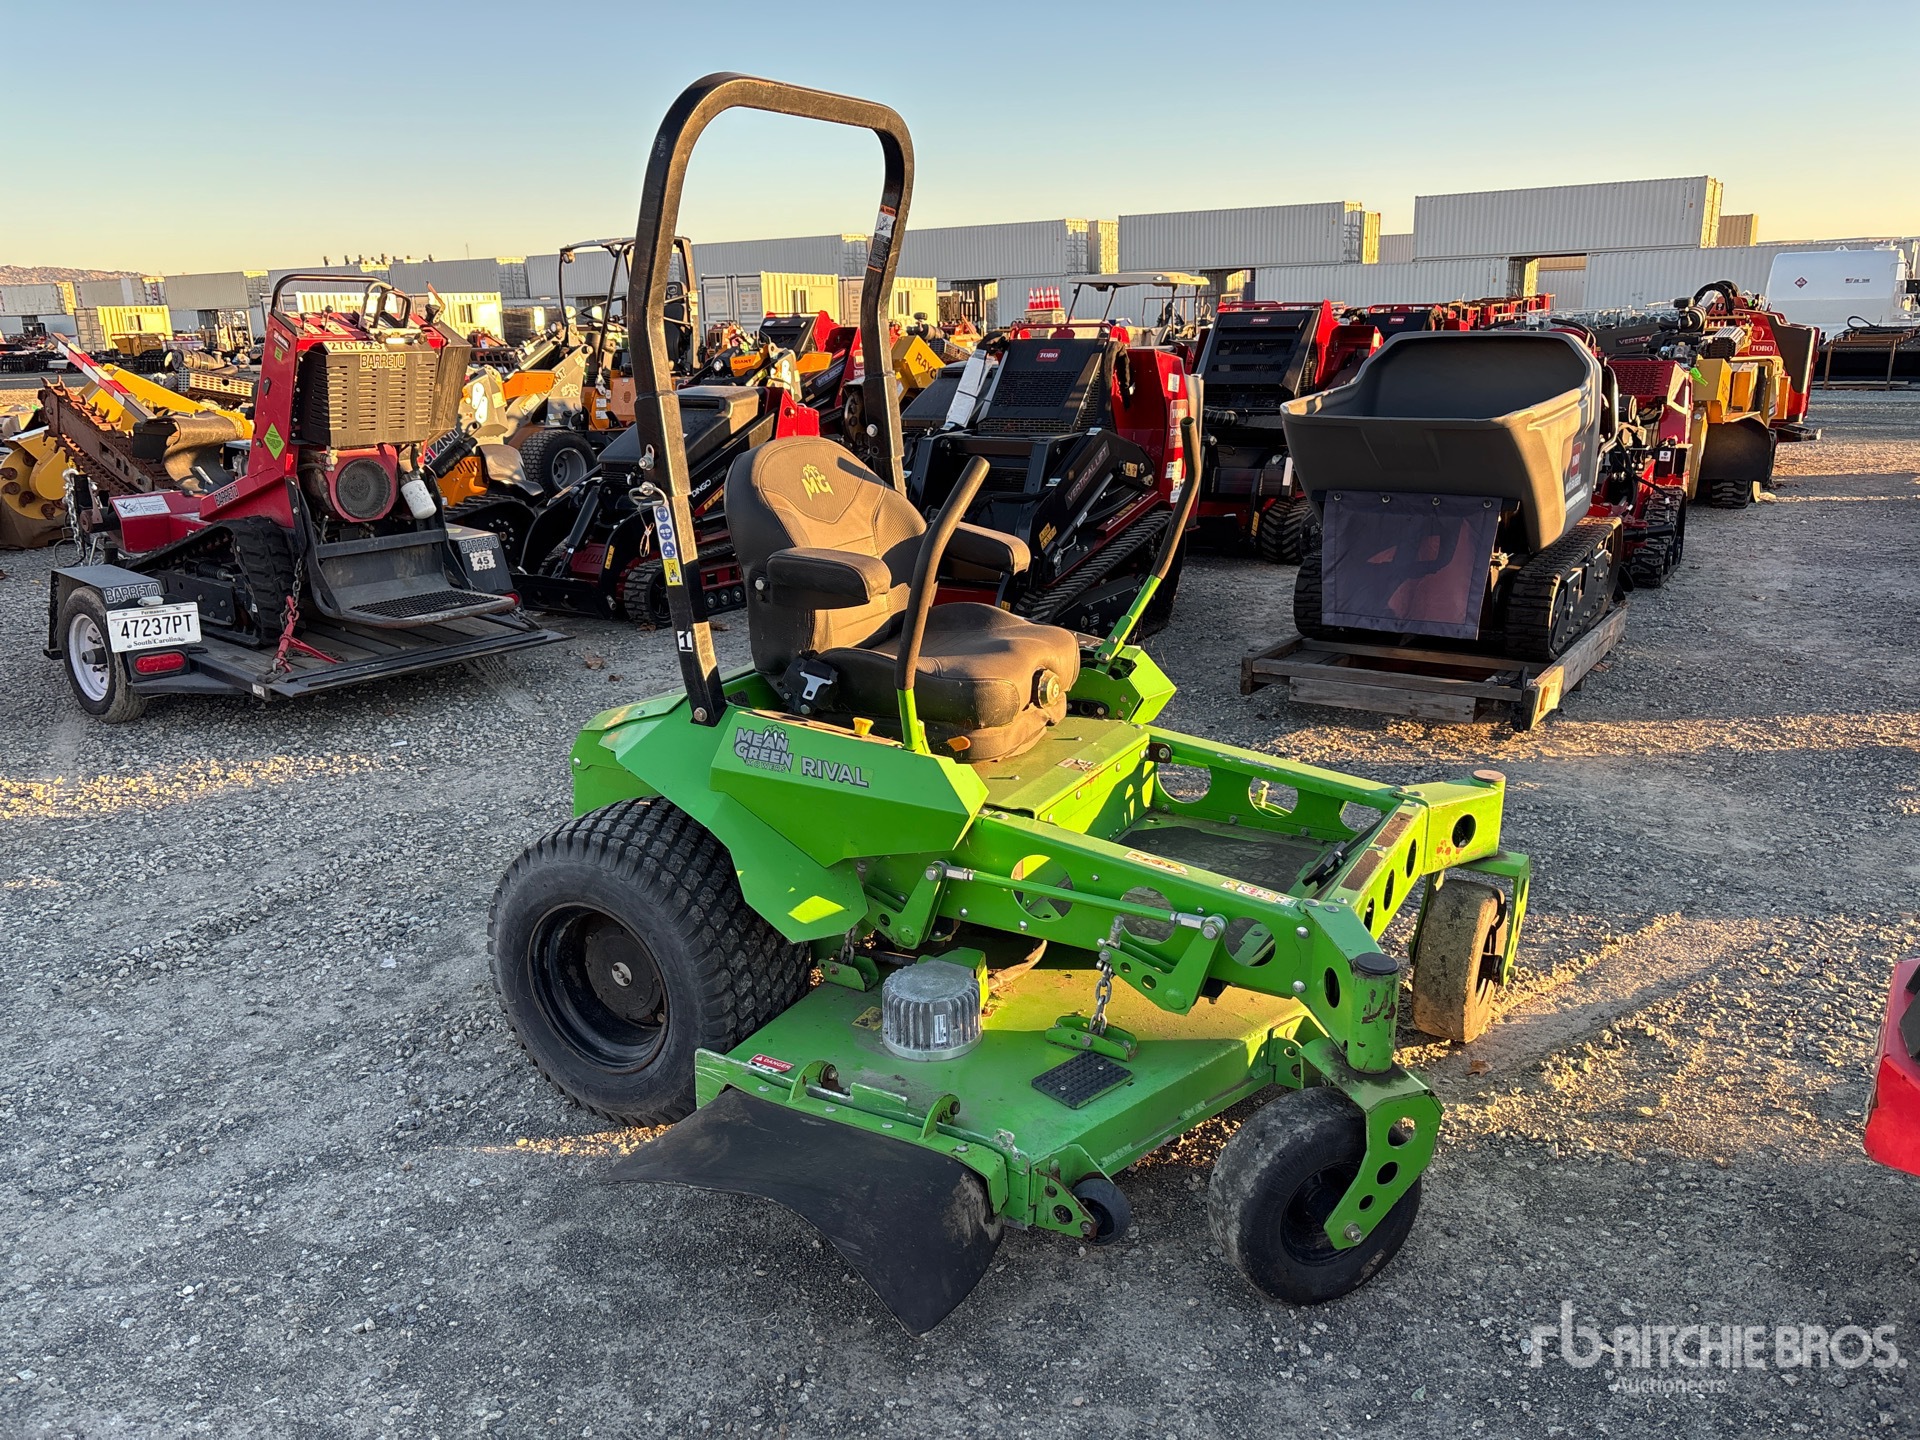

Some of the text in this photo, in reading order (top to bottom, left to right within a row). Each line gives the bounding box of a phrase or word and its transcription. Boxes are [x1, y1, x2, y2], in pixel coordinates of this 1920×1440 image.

[331, 341, 383, 351] 2767225
[1618, 335, 1651, 345] VERTICA
[1750, 344, 1774, 352] TORO
[359, 353, 407, 369] BARRETO
[1039, 351, 1059, 359] TORO
[915, 351, 937, 380] RAYC
[424, 427, 460, 466] GIANT
[1067, 446, 1108, 502] VERTICAL LIFT
[214, 484, 240, 508] BARRETO
[691, 479, 711, 498] DINGO
[458, 536, 500, 554] BARRETO
[476, 556, 490, 565] 45
[103, 583, 161, 604] BARRETO
[140, 608, 168, 616] Permanent
[120, 614, 193, 639] 47237PT
[133, 637, 153, 648] South
[678, 631, 693, 650] 1
[735, 727, 790, 751] MEAN
[734, 741, 794, 770] GREEN
[745, 759, 787, 774] MOWERS
[801, 755, 870, 788] RIVAL
[763, 1057, 791, 1070] DANGER
